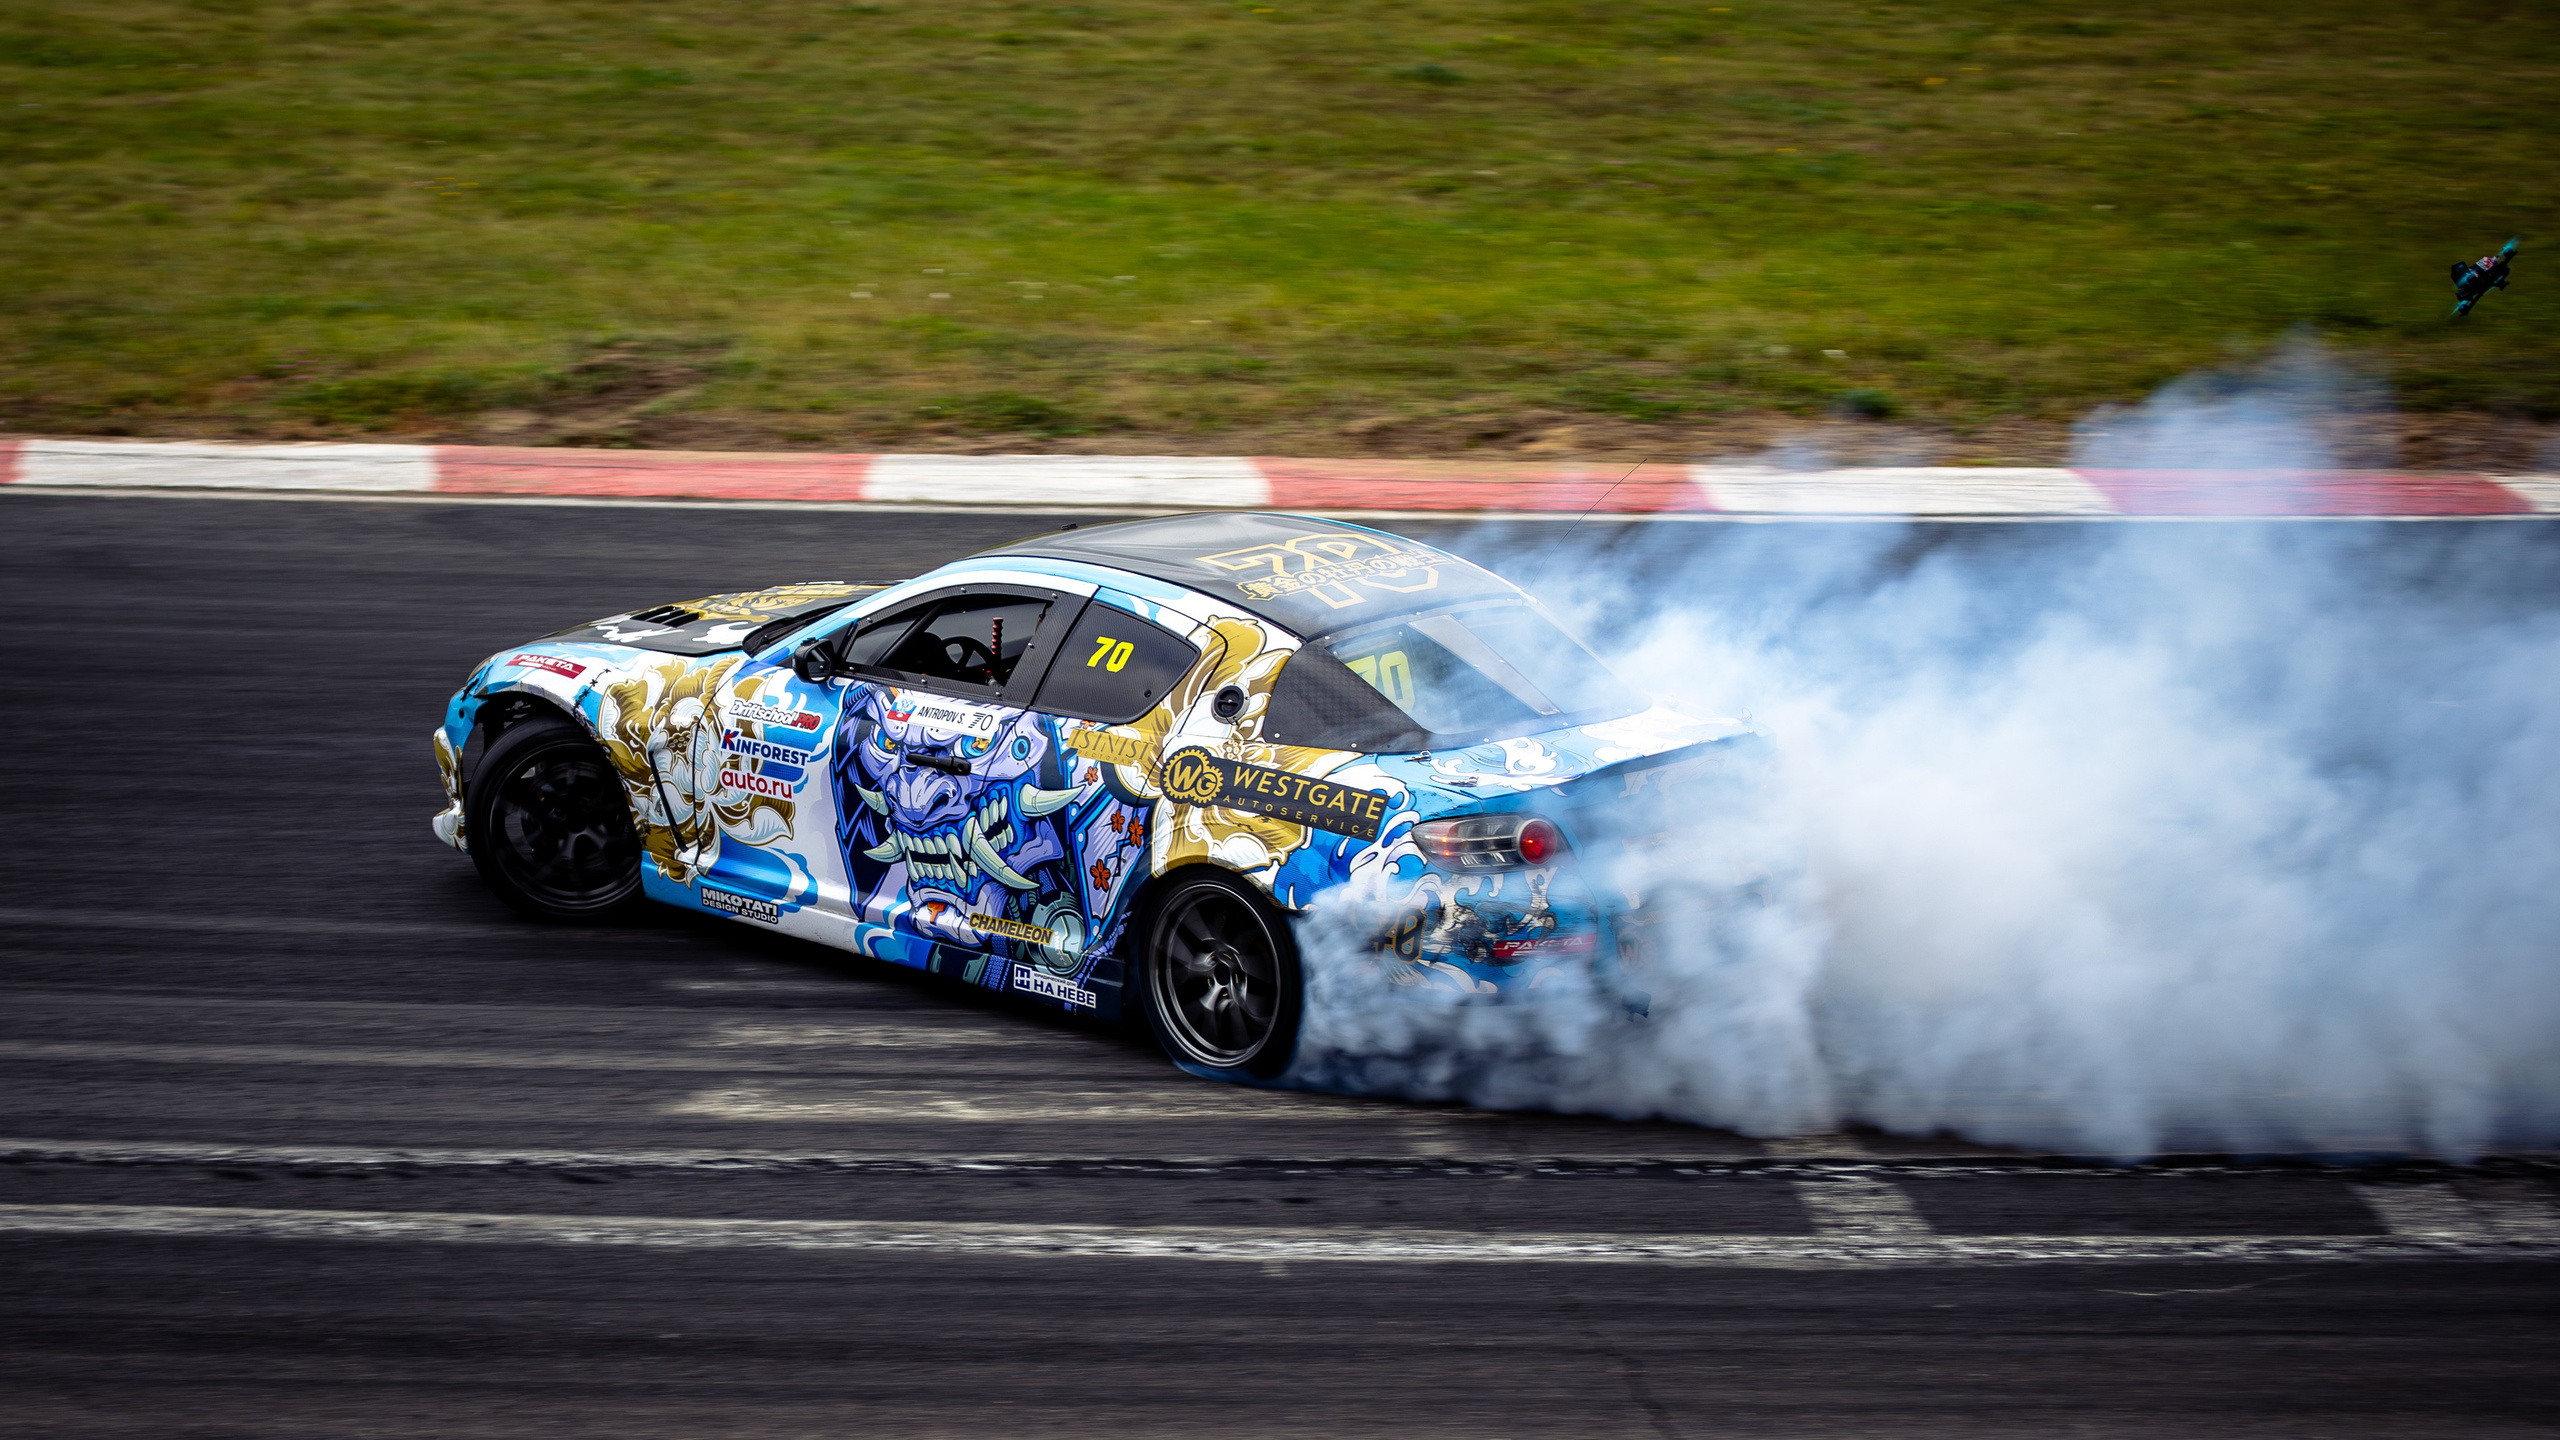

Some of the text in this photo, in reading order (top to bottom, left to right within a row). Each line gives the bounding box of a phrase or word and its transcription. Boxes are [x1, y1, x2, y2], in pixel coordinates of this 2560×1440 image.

[1087, 636, 1134, 673] 70
[917, 706, 958, 722] ANTROPOV
[957, 713, 966, 724] S.
[721, 729, 808, 766] KINFOREST
[721, 771, 792, 799] auto.ru
[1233, 766, 1385, 820] WESTGATE
[1222, 795, 1375, 838] AUTOSERVICE
[702, 888, 777, 915] MIKOTATI
[703, 899, 777, 923] DESIGN STUDIO
[969, 914, 1053, 943] CHAMELEON
[1033, 980, 1095, 1006] НА НЕВЕ
